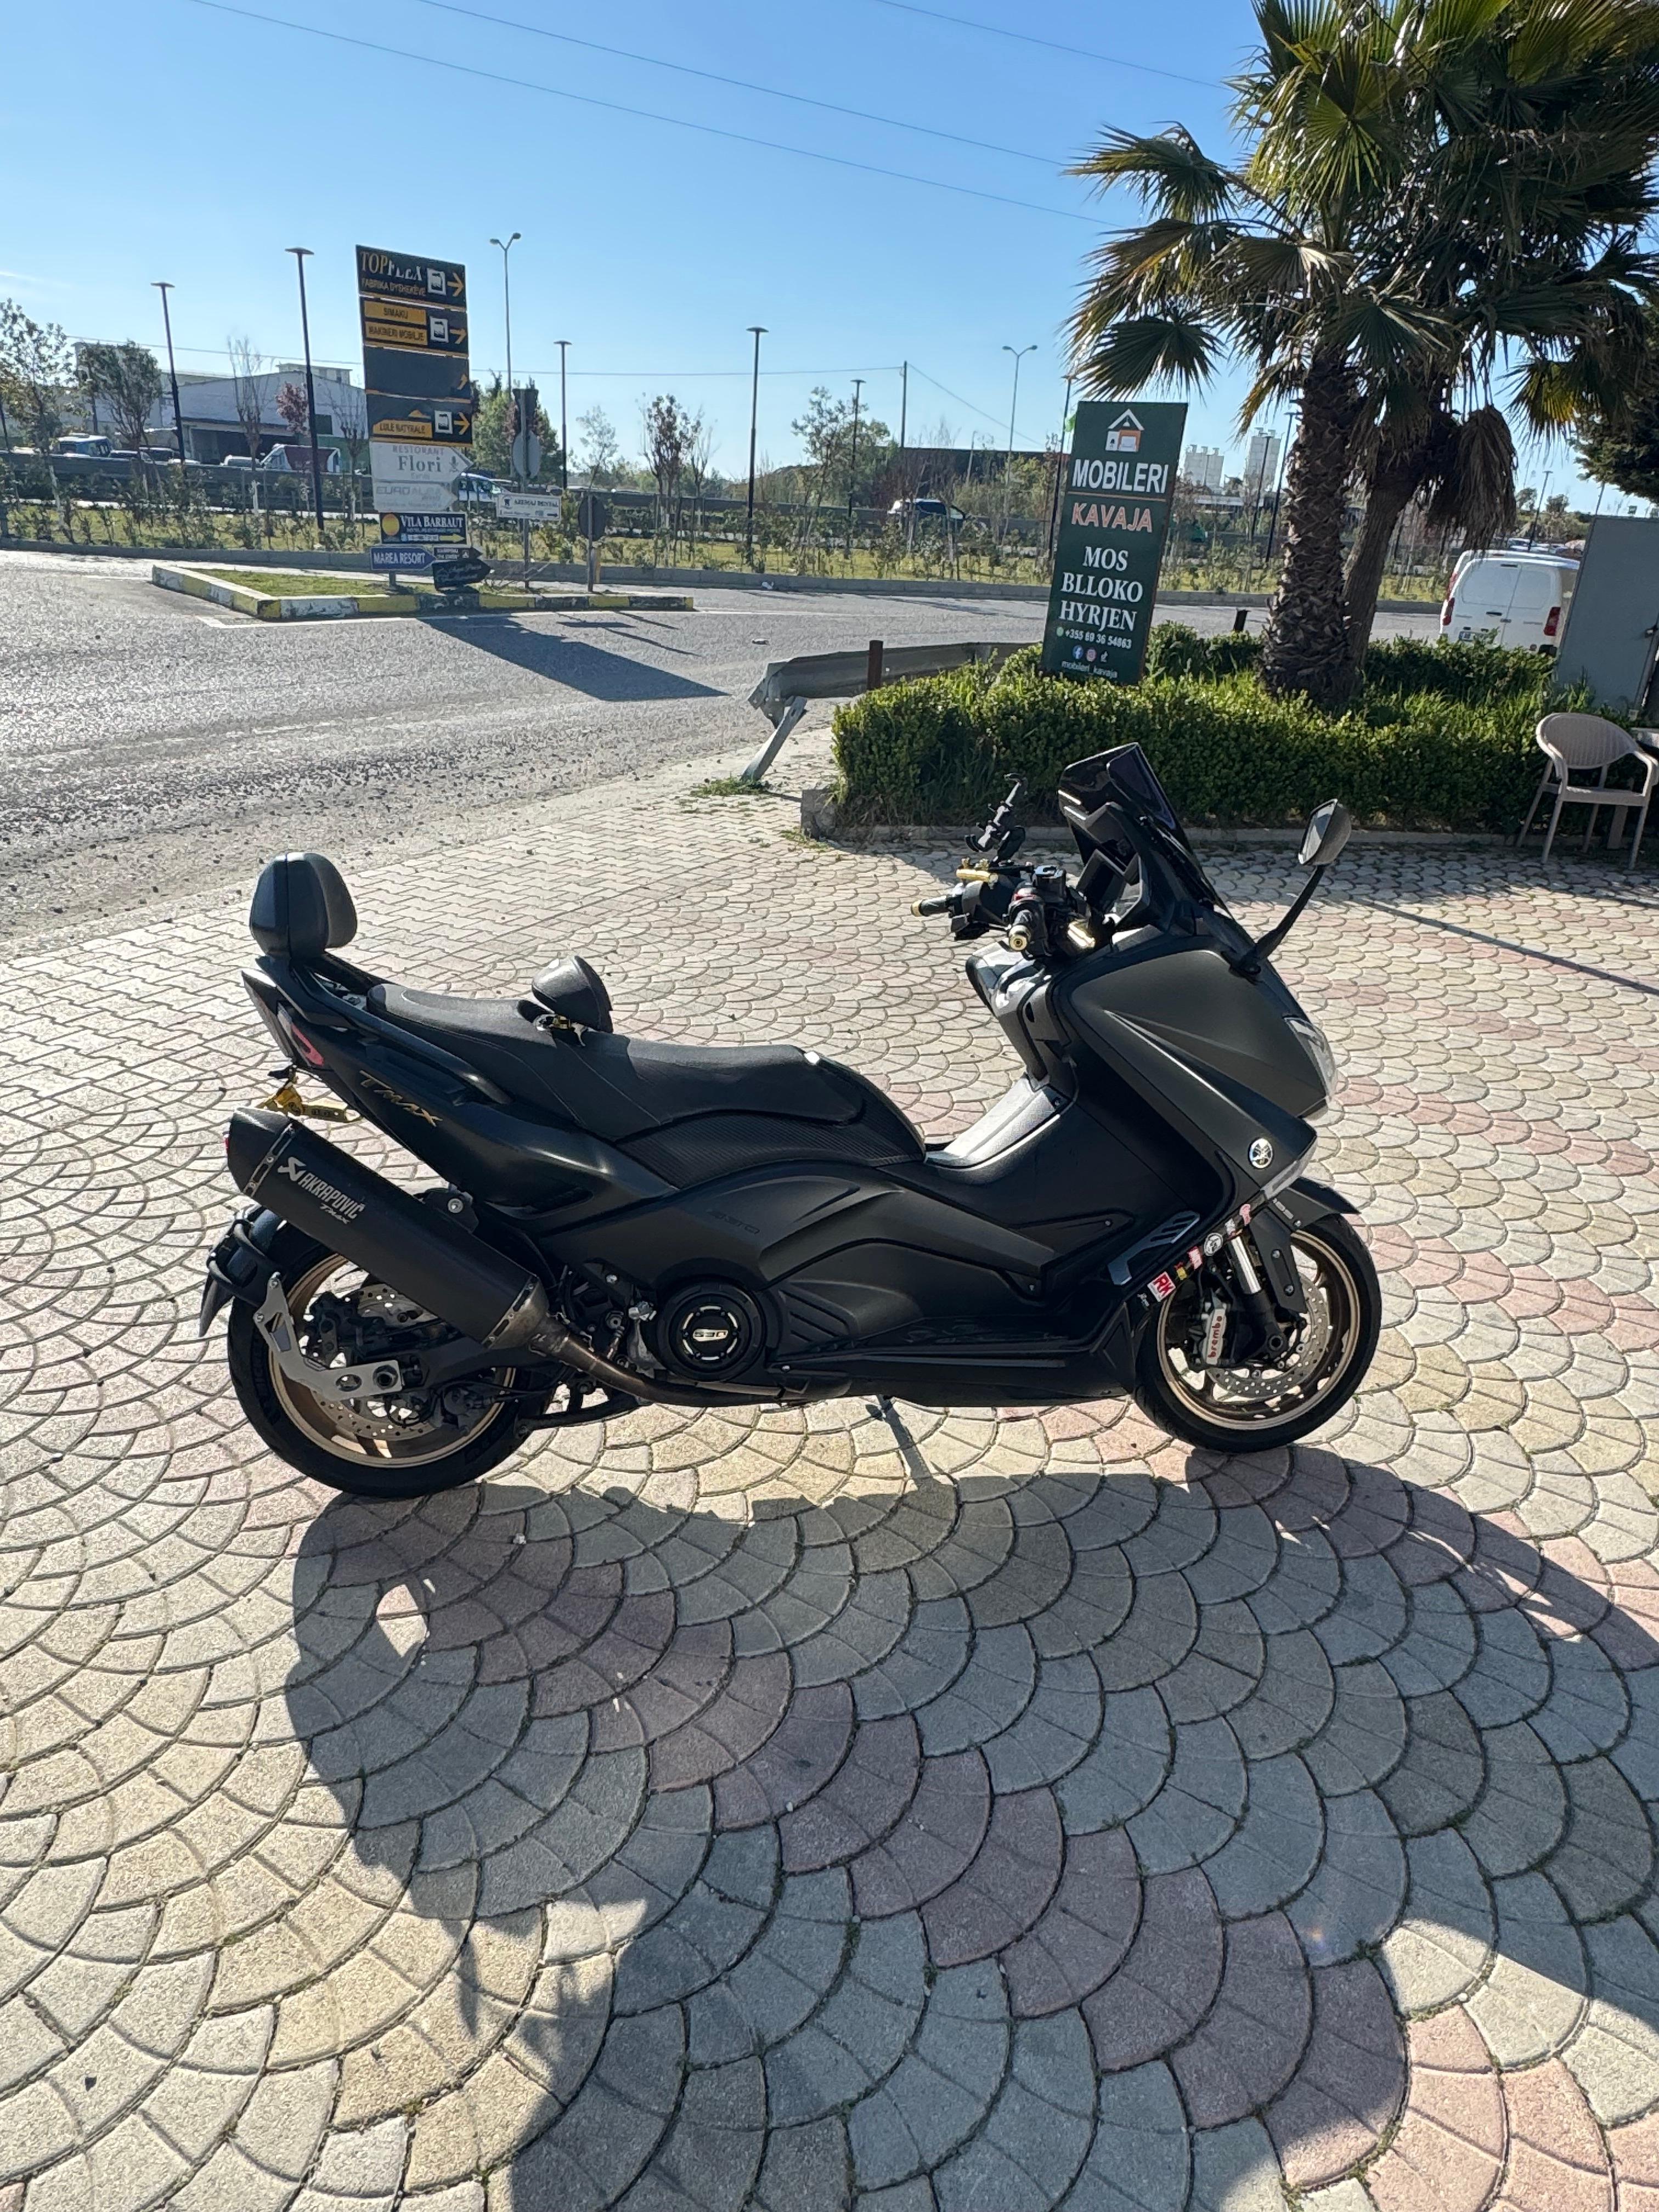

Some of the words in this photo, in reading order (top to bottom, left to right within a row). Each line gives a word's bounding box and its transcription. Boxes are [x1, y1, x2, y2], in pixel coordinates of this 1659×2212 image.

[398, 455, 441, 472] Flori
[1072, 459, 1169, 494] MOBILERI
[400, 515, 422, 527] VILA
[1071, 503, 1152, 533] KAVAJA
[374, 552, 399, 563] MAREA
[399, 553, 426, 565] RESORT
[1082, 546, 1128, 572] MOS
[1060, 572, 1143, 602] BLLOKO
[1058, 600, 1137, 631] HYRJEN
[1065, 629, 1084, 641] +355
[1096, 633, 1106, 644] 36
[1207, 1316, 1223, 1358] brembo
